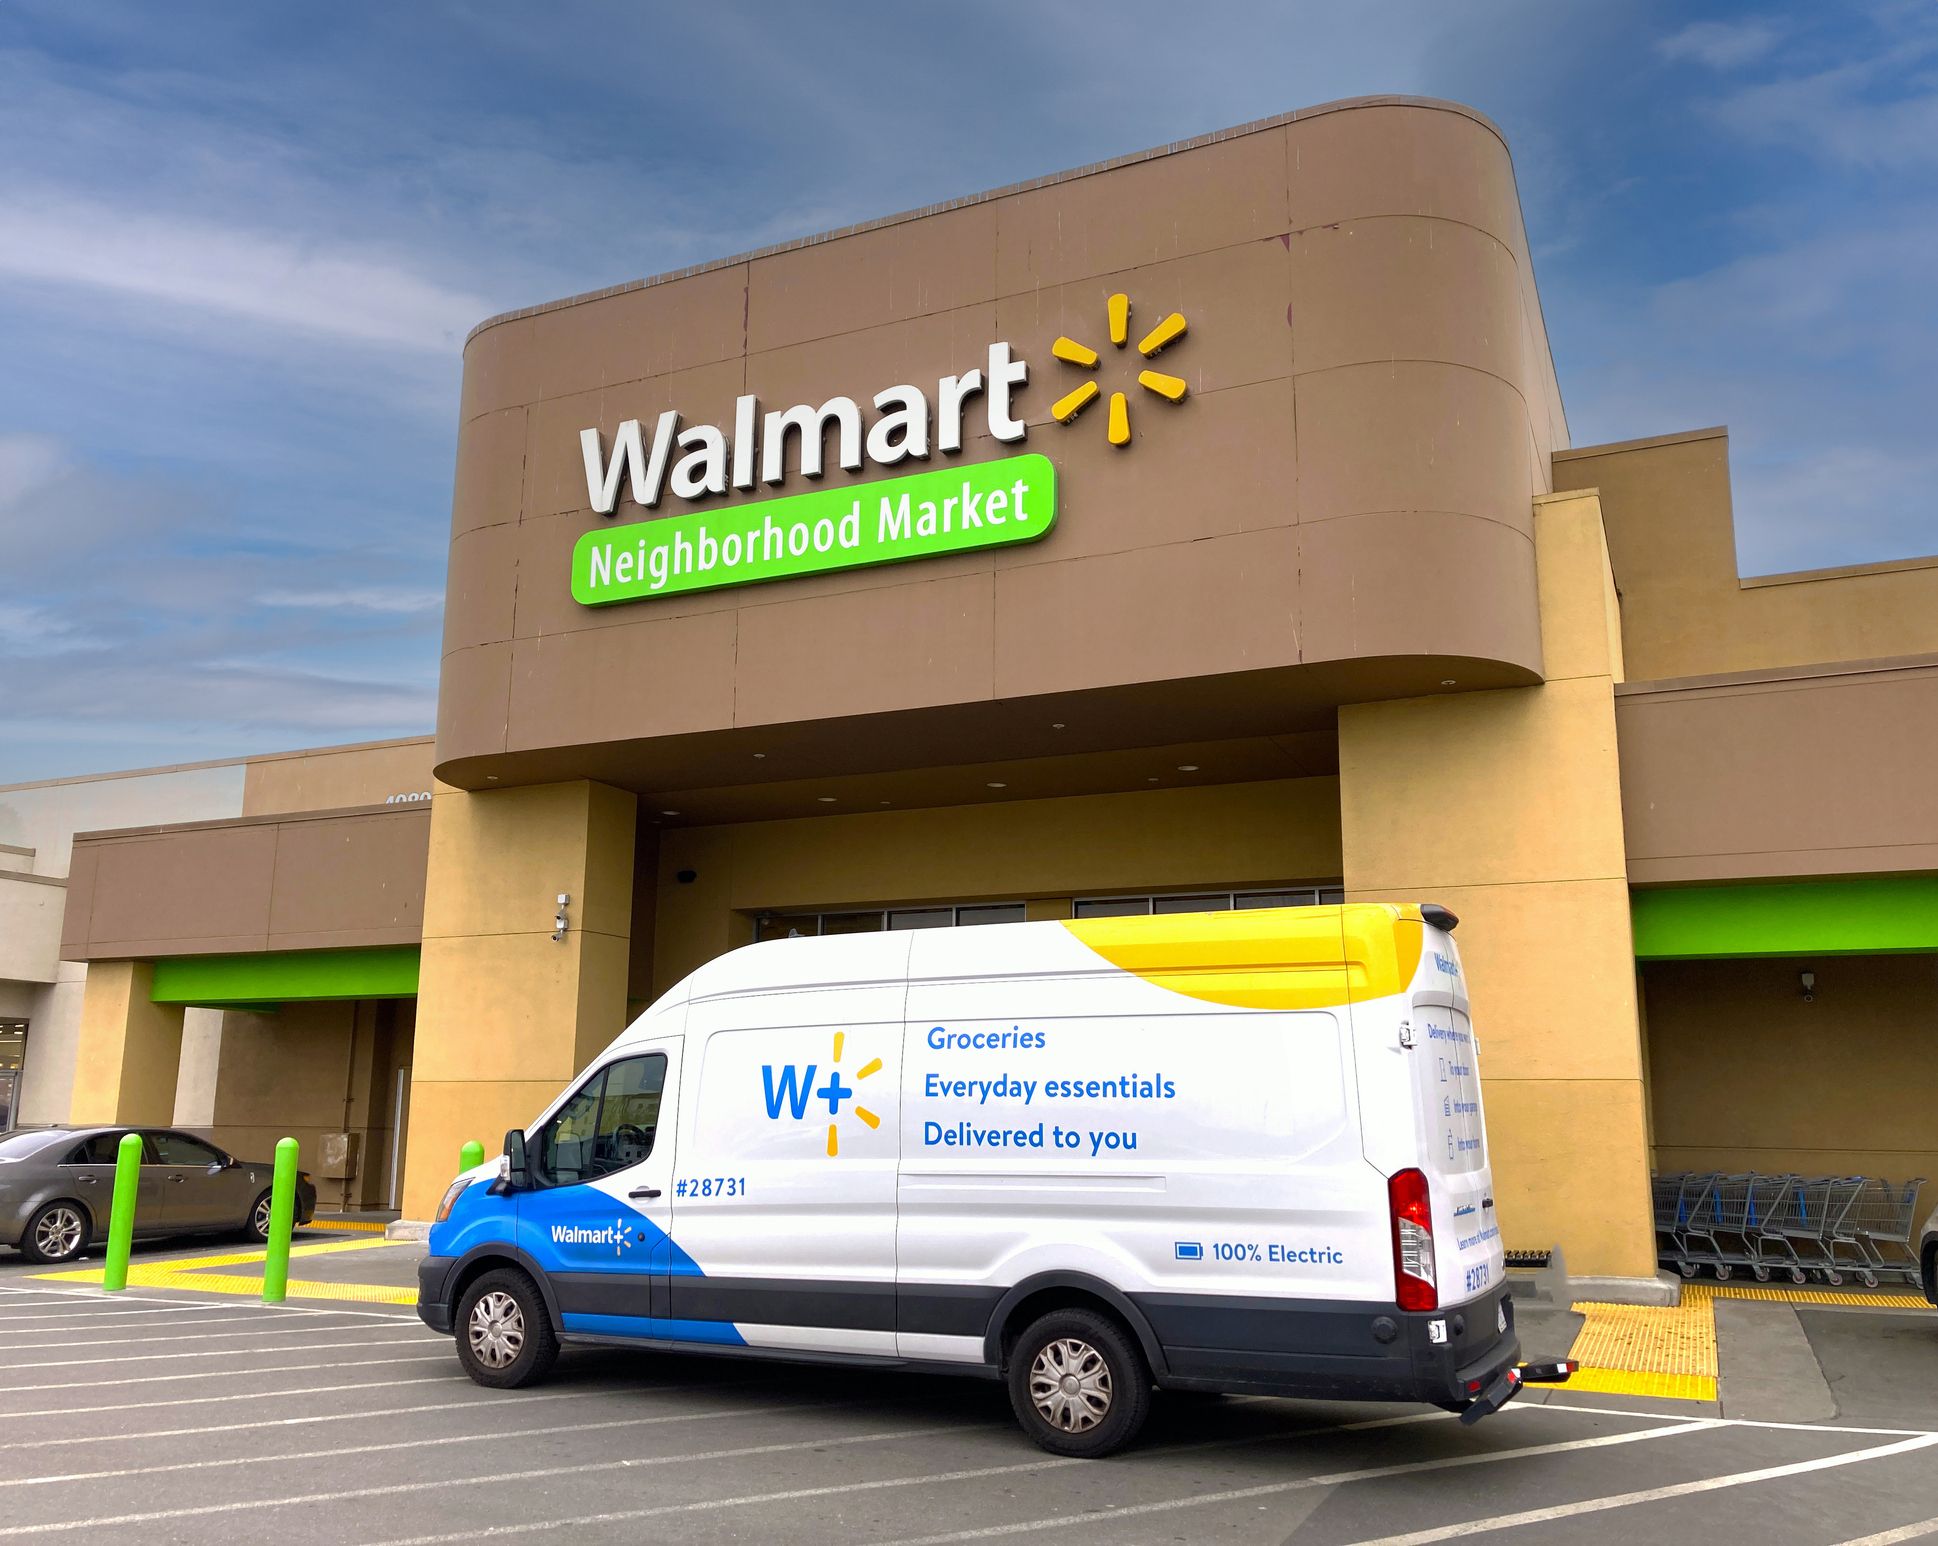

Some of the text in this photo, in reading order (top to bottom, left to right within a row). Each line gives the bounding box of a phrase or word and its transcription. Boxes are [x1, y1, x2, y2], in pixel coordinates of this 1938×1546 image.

[580, 341, 1028, 516] Walmart
[589, 478, 1030, 590] Neighborhood Market
[926, 1025, 1046, 1050] Groceries
[924, 1073, 1176, 1105] Everyday essentials
[924, 1121, 1138, 1156] Delivered to you
[676, 1177, 746, 1198] #28731
[1212, 1243, 1344, 1264] 100% Electric
[1466, 1263, 1490, 1293] #28731
